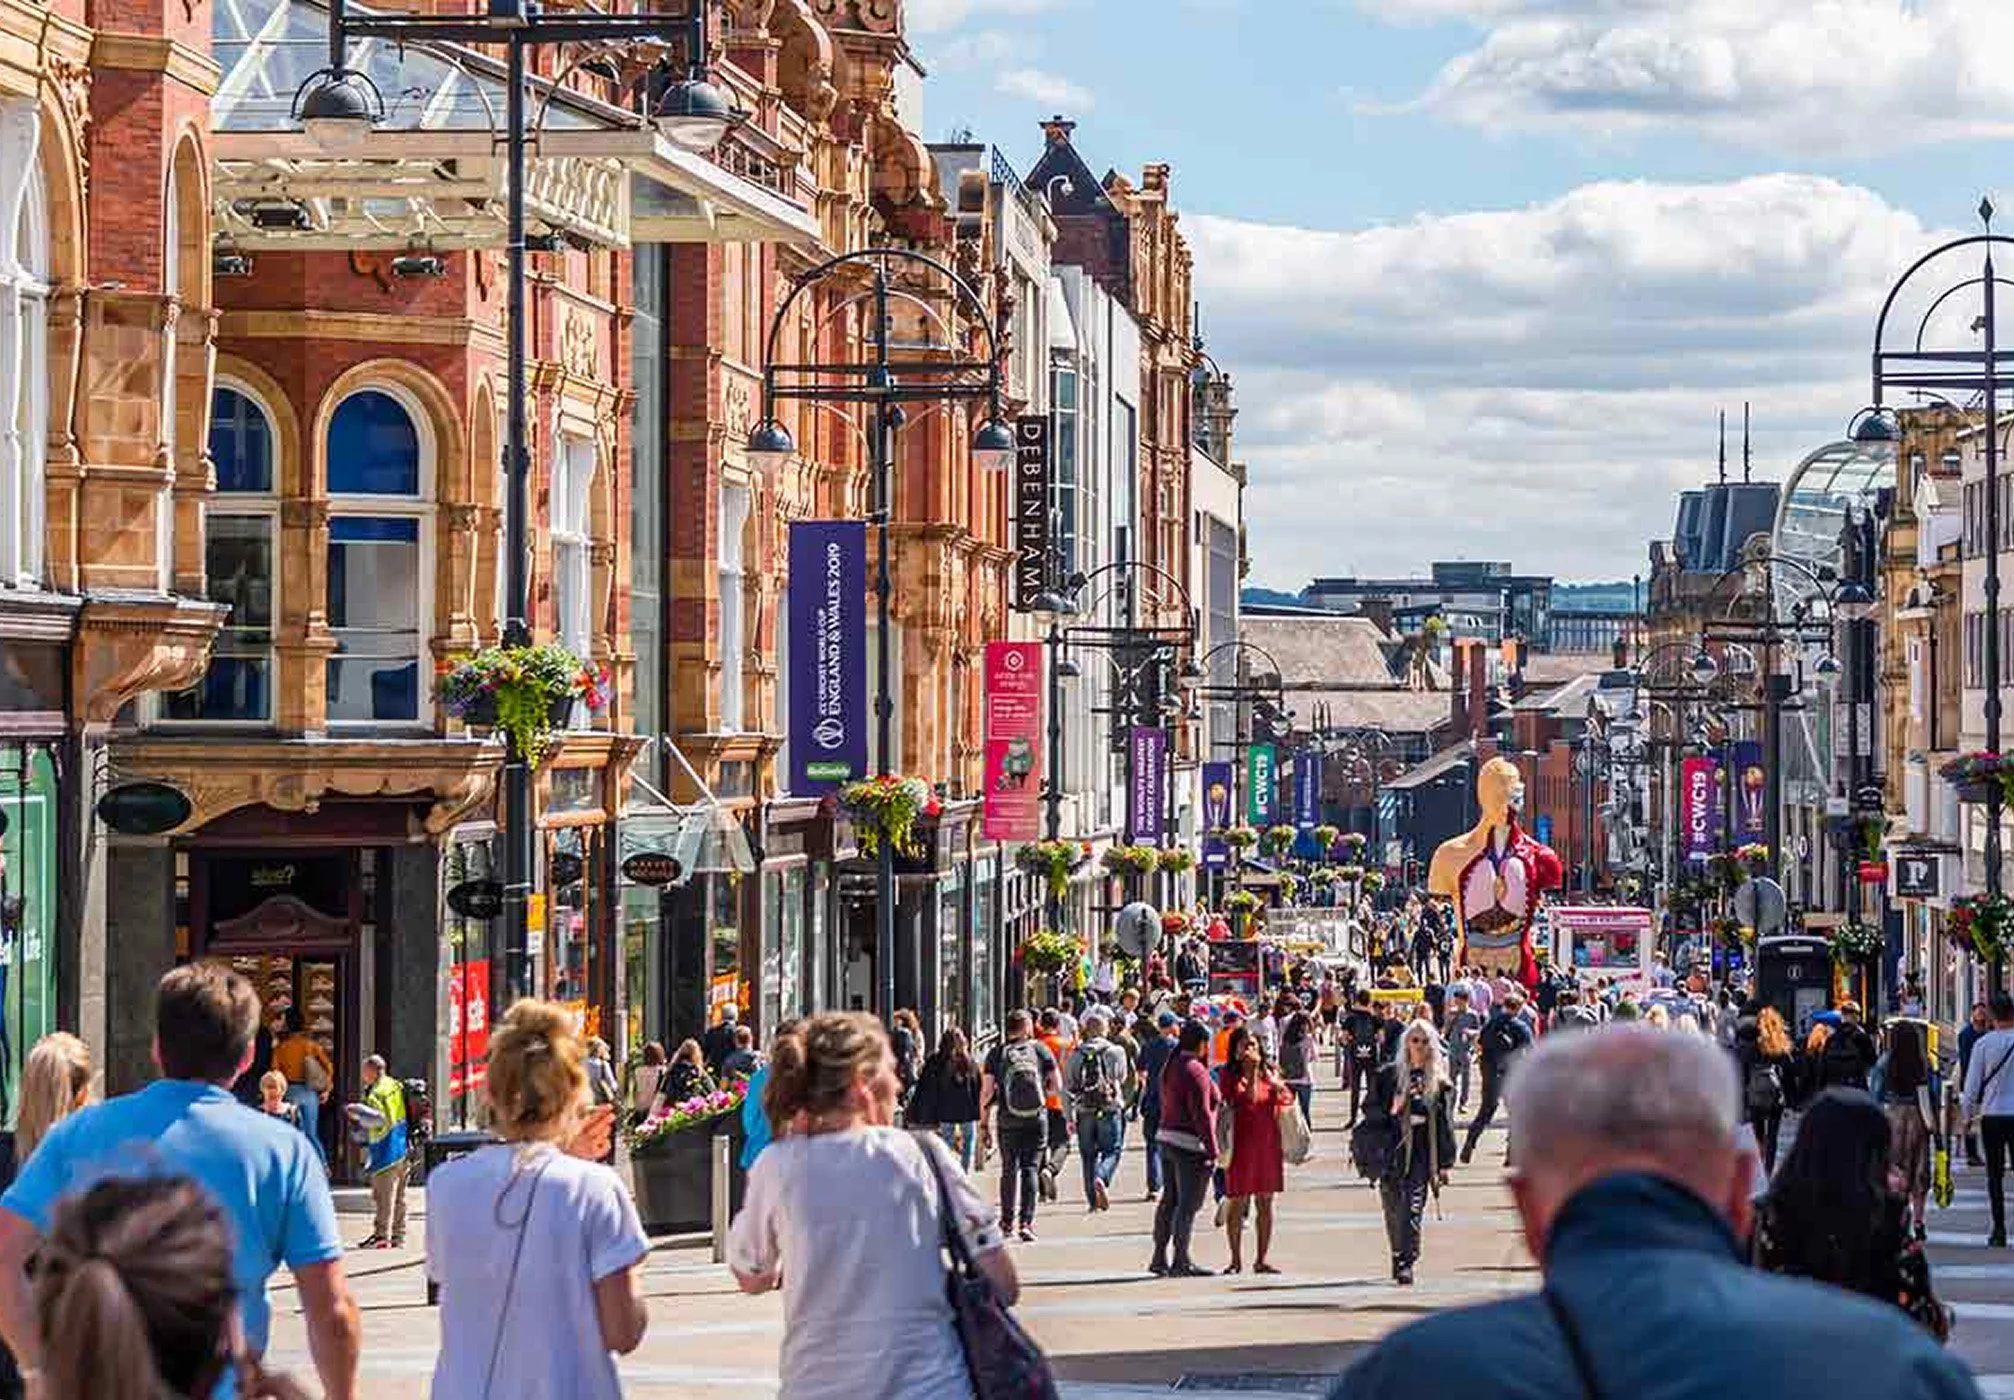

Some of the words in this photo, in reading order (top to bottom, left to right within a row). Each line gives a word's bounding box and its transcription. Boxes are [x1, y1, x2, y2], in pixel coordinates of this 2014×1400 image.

[1022, 423, 1042, 606] DEBENHAMS
[827, 543, 841, 578] 2019
[817, 607, 827, 628] CUP
[827, 580, 841, 629] WALES
[818, 629, 827, 661] WORLD
[827, 630, 841, 643] &
[818, 662, 827, 701] CRICKET
[828, 644, 841, 716] ENGLAND
[1691, 771, 1706, 843] #CWC19
